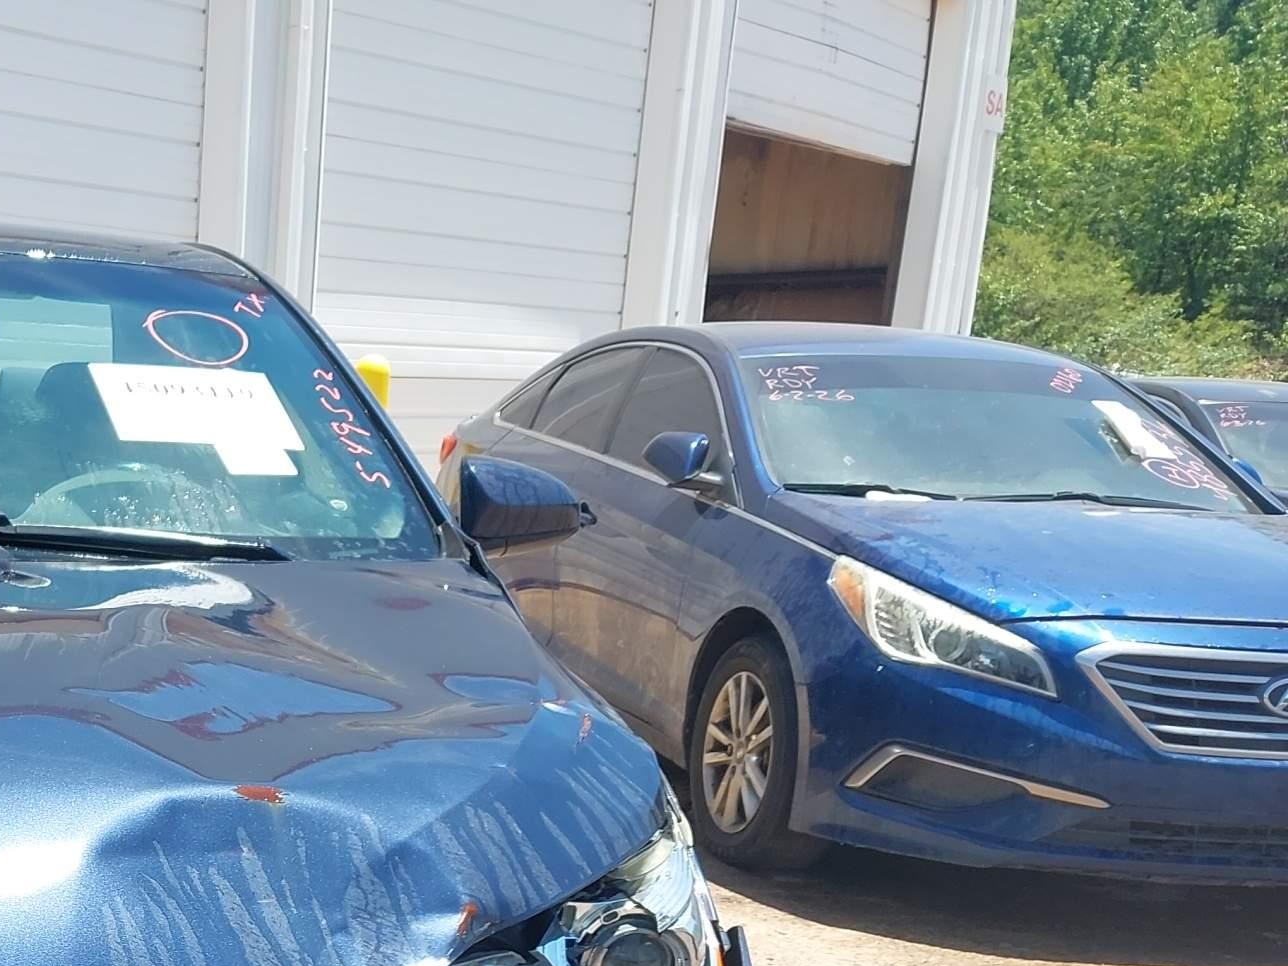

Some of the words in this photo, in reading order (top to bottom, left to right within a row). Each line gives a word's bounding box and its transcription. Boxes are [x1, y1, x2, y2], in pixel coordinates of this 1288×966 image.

[233, 293, 265, 318] TX
[758, 365, 820, 378] VRT
[765, 377, 817, 389] RDY
[768, 389, 855, 401] 6-2-26
